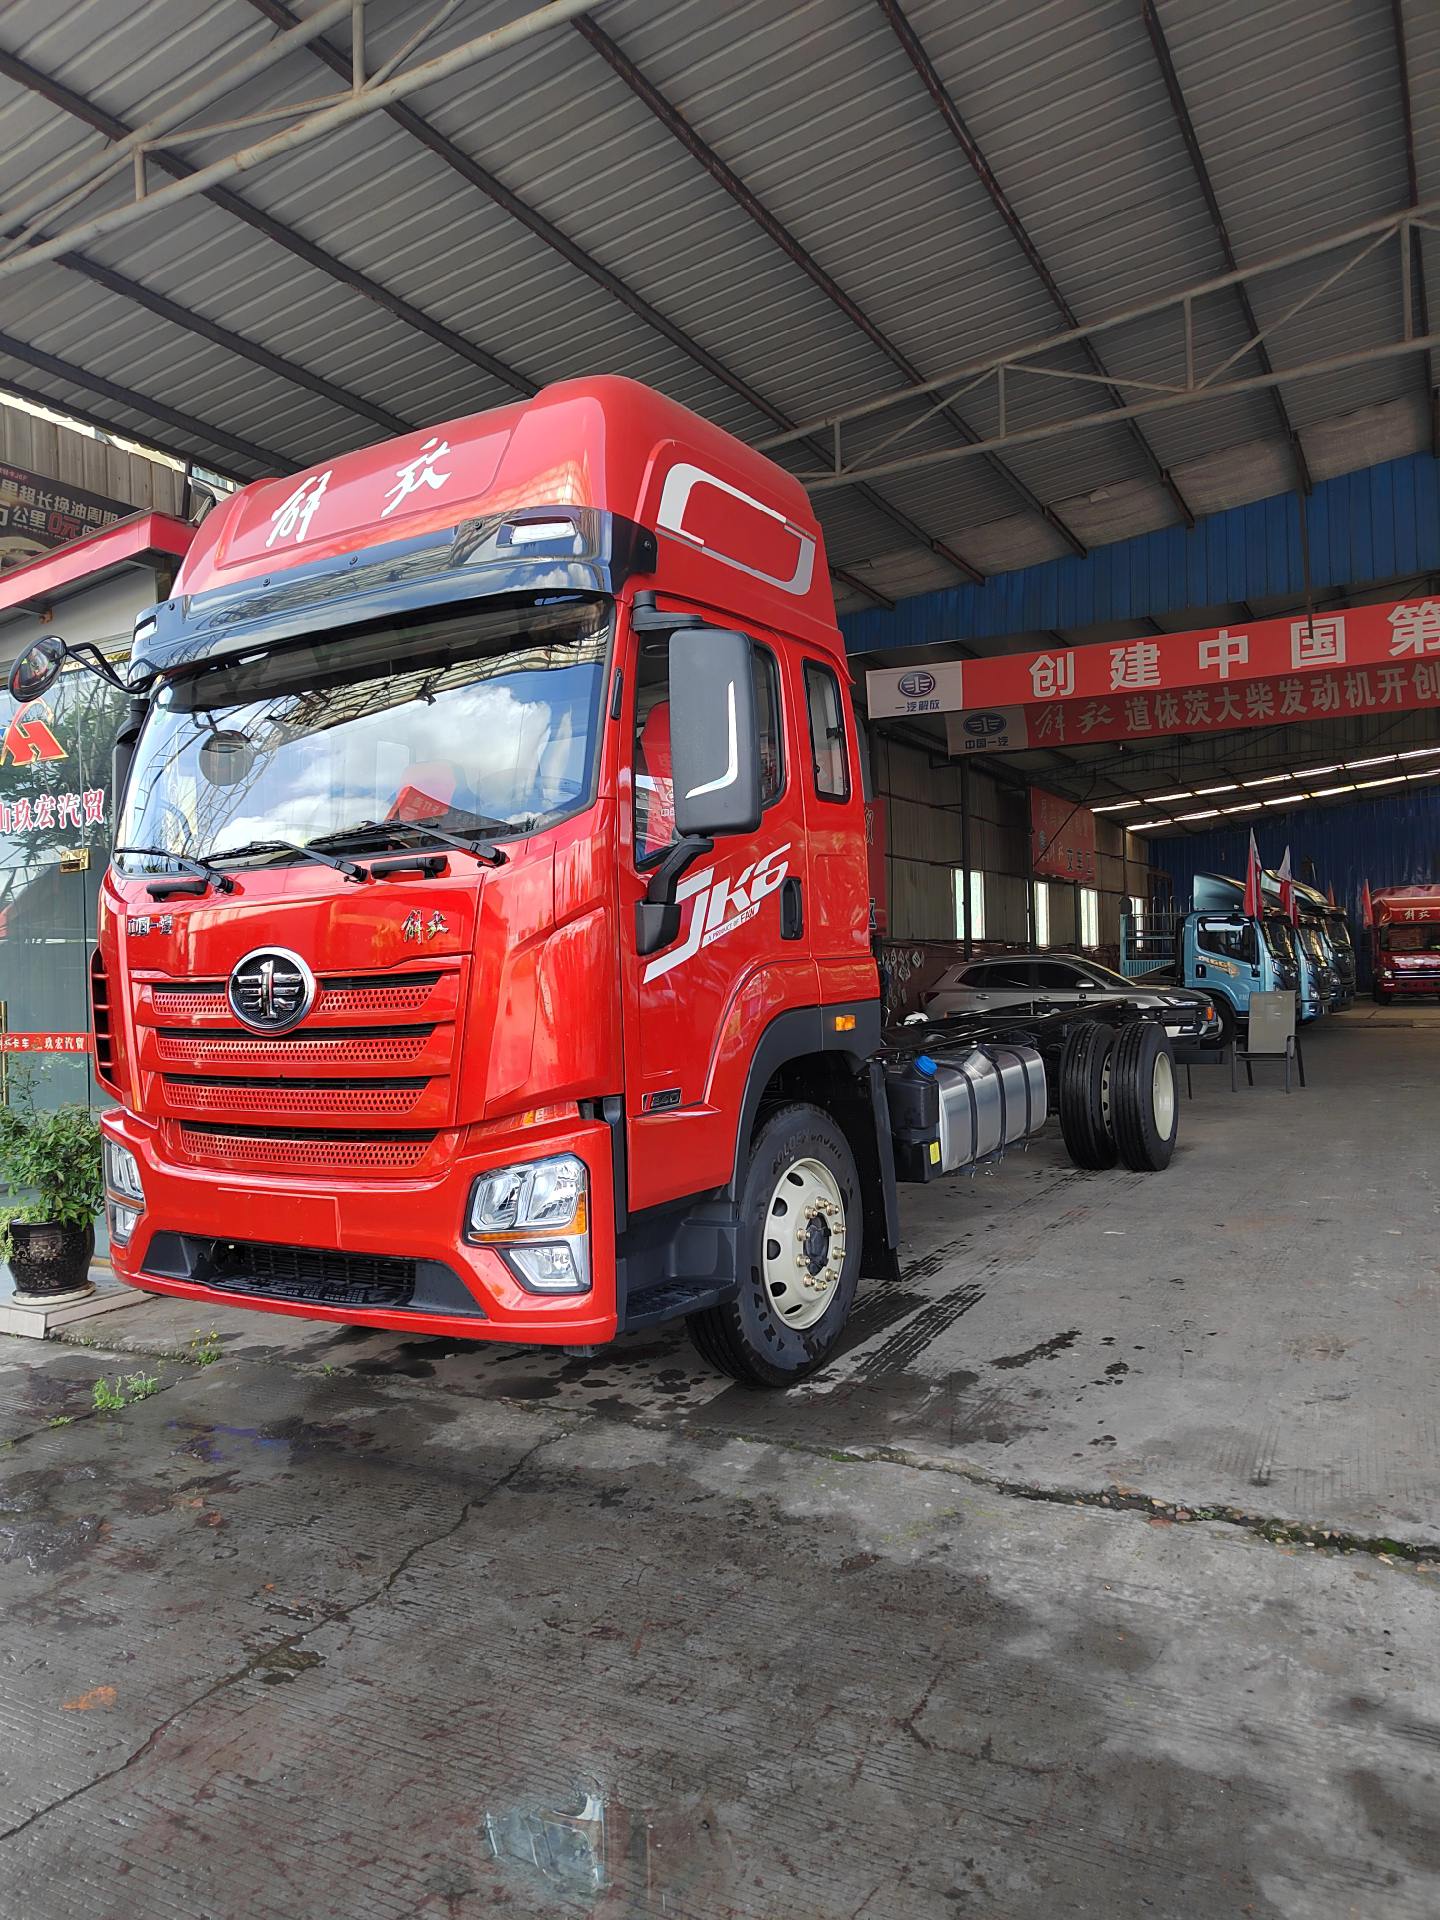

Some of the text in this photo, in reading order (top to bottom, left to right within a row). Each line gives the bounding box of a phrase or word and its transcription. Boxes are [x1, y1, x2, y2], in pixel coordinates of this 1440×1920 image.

[1028, 601, 1440, 698] 创建中国第
[895, 699, 940, 712] 一汽解放
[965, 736, 1009, 750] 中国一汽
